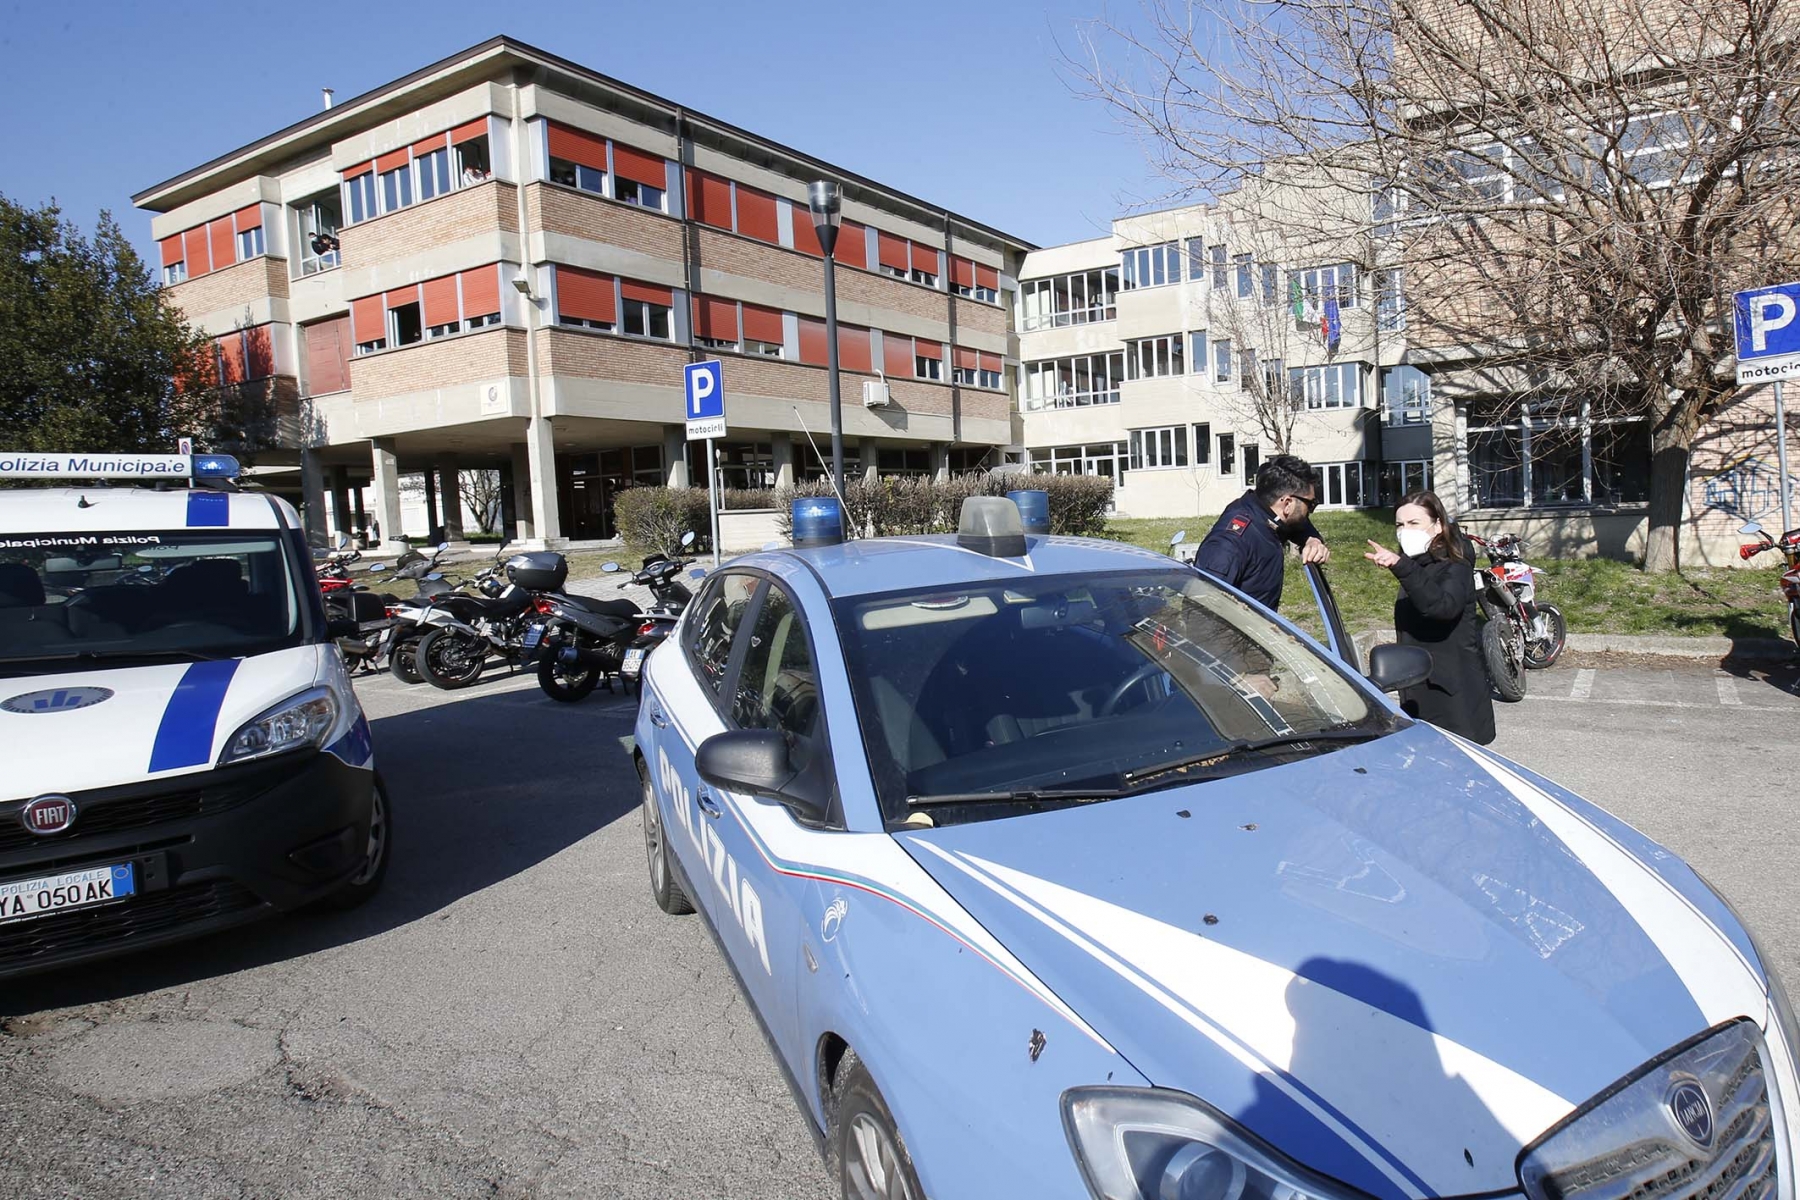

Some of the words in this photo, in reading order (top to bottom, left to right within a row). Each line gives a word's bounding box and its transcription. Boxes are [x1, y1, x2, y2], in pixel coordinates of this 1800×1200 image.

[1749, 293, 1796, 352] P
[691, 368, 715, 414] P
[35, 805, 66, 826] FIAT
[1, 880, 49, 896] POLIZIA
[57, 870, 104, 887] LOCALE
[659, 745, 772, 976] POLIZIA
